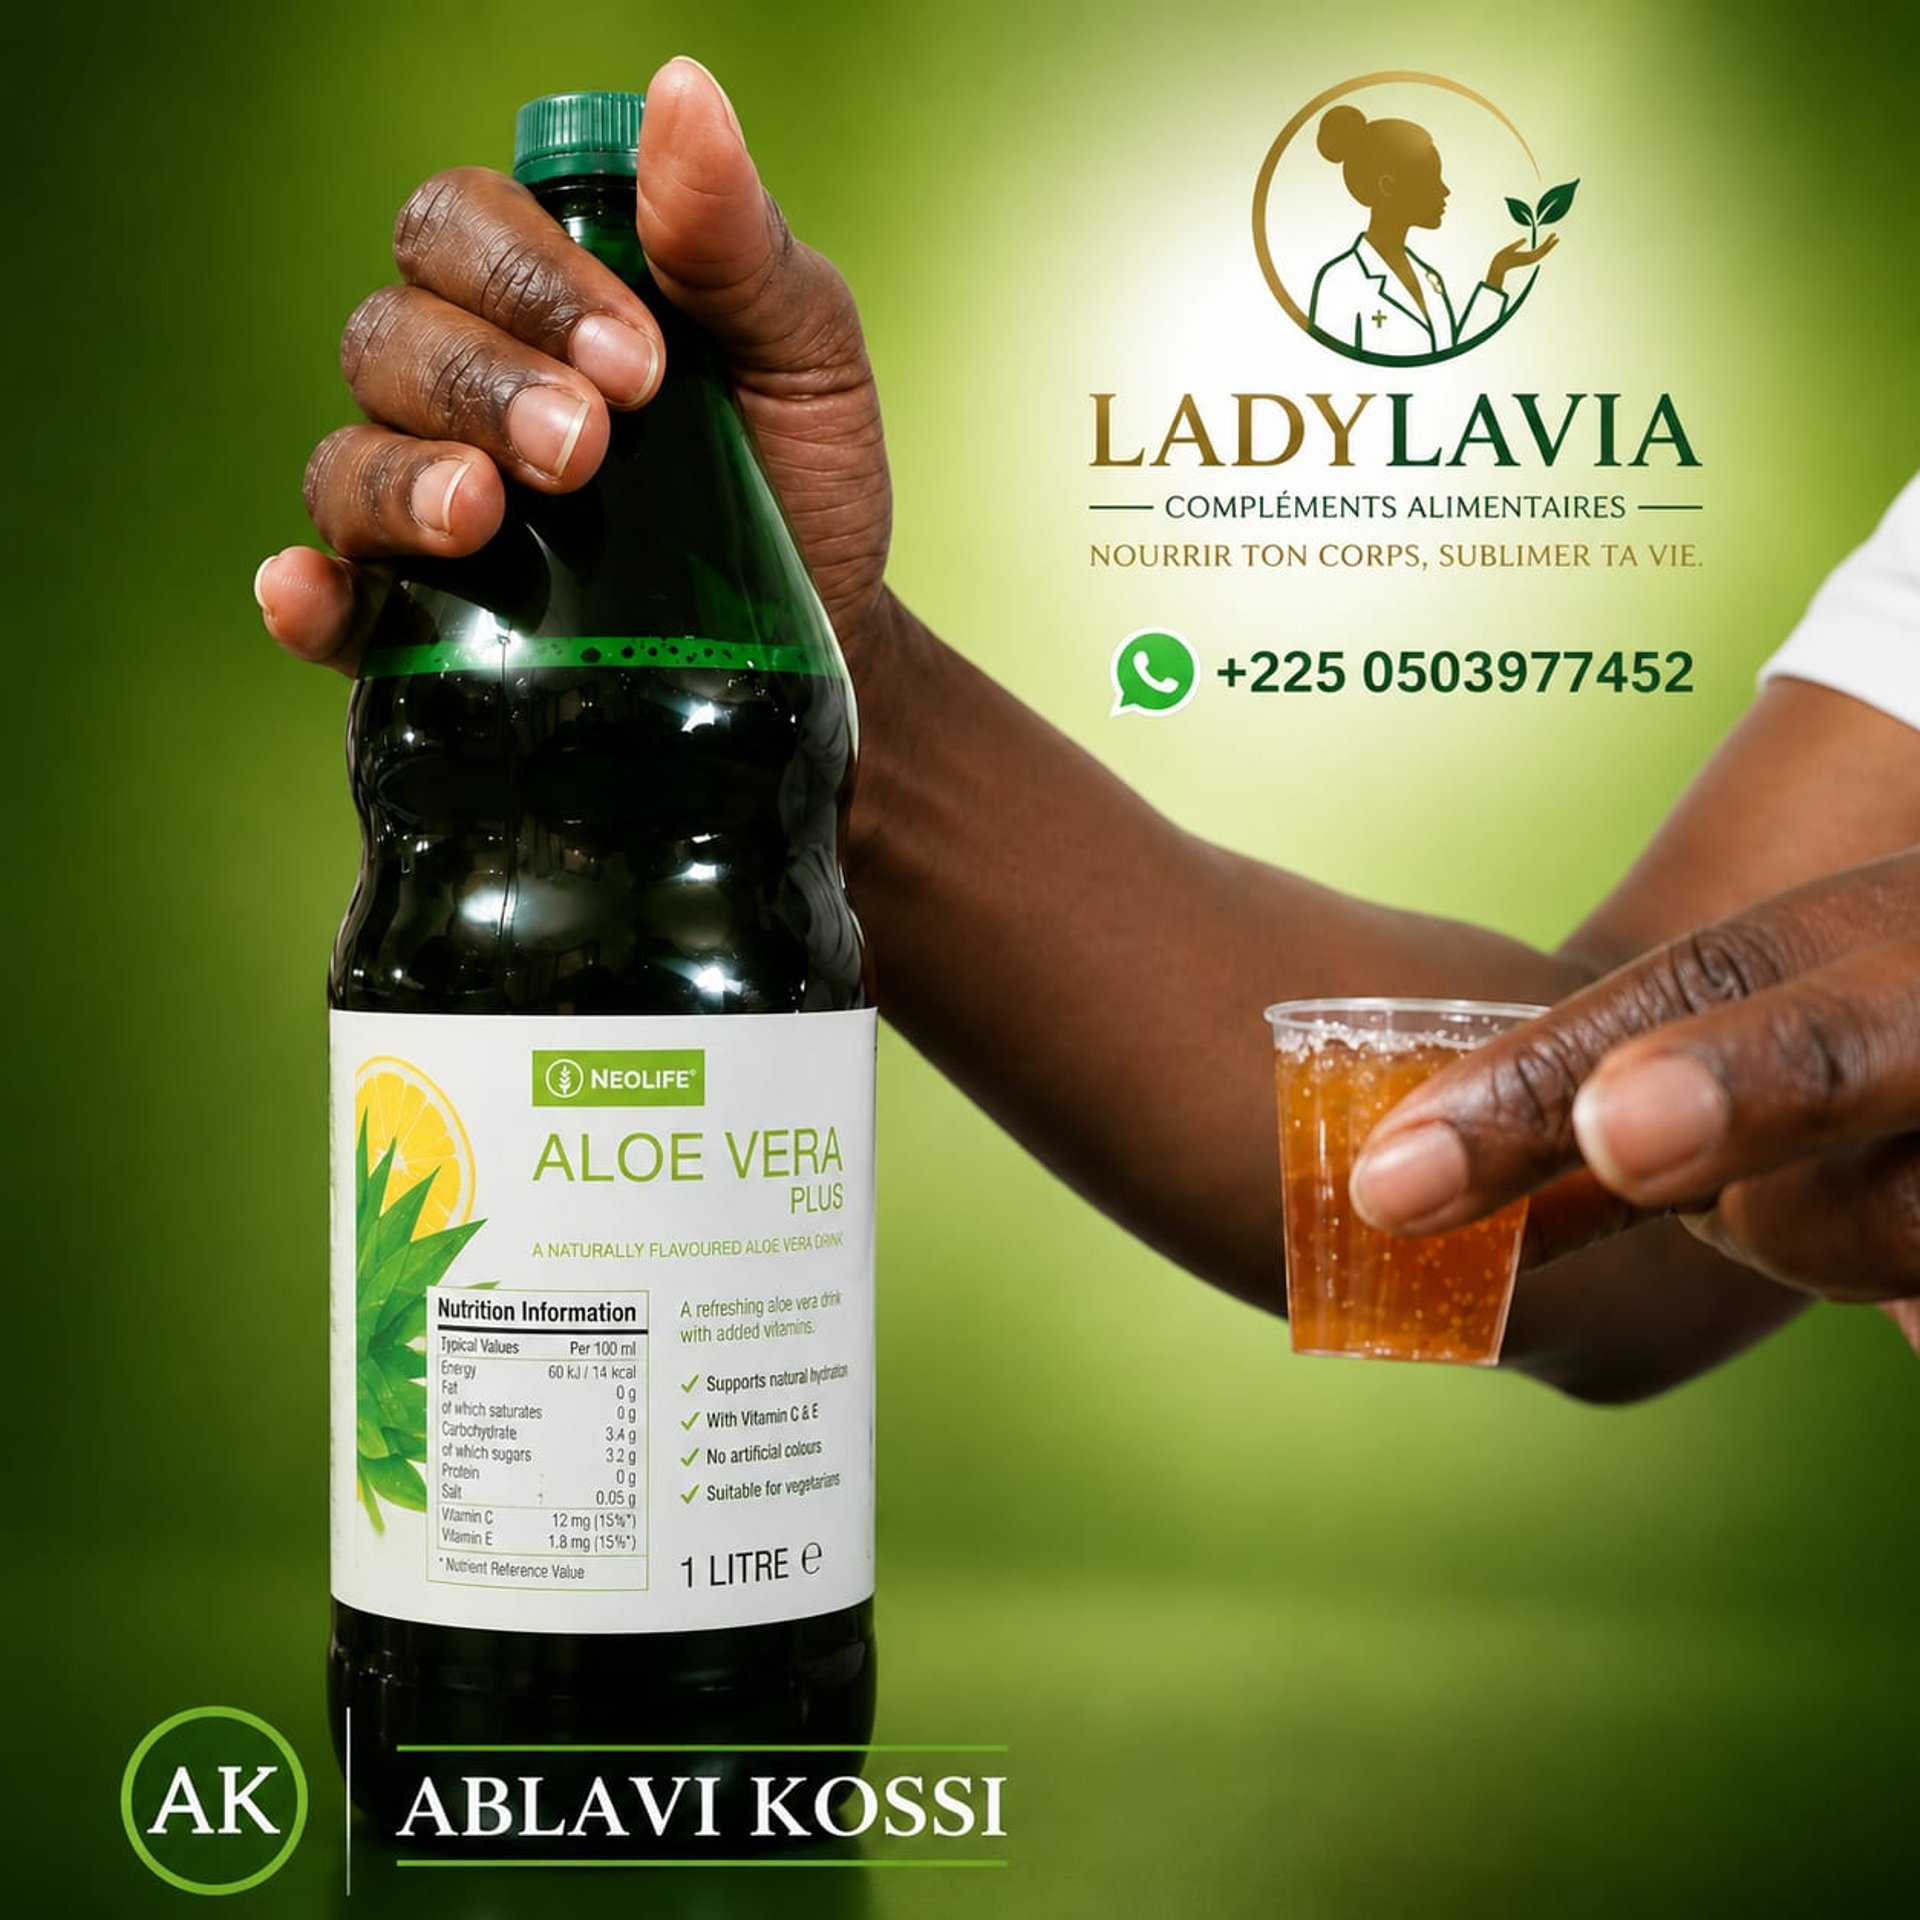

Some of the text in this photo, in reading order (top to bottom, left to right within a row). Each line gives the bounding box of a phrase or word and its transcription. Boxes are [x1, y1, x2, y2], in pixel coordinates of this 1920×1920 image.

[532, 1127, 843, 1183] ALOE VERA
[790, 1183, 843, 1214] PLUS
[532, 1234, 843, 1259] A NATURALLY FLAVOURED ALOE VERA DRINK
[438, 1297, 636, 1322] Nutrition Information
[680, 1301, 691, 1318] A
[696, 1297, 764, 1319] refreshing
[768, 1295, 793, 1313] aloe
[796, 1294, 819, 1310] vera
[681, 1318, 816, 1343] with added vitamins.
[481, 1339, 519, 1354] Values
[570, 1341, 636, 1356] Per 100 ml
[441, 1361, 476, 1379] Energy
[548, 1365, 564, 1379] 60
[567, 1365, 581, 1379] kJ
[594, 1366, 607, 1379] 14
[611, 1365, 636, 1379] kcal
[441, 1380, 458, 1394] Fat
[706, 1373, 766, 1394] Supports
[769, 1368, 808, 1386] natural
[616, 1385, 636, 1402] 0 g
[441, 1401, 543, 1419] of which saturates
[616, 1406, 636, 1423] 0 g
[706, 1403, 819, 1429] With Vitamin C & E
[628, 1430, 636, 1444] g
[441, 1444, 532, 1464] of which sugars
[628, 1451, 636, 1465] g
[706, 1440, 822, 1465] No artificial colours
[441, 1463, 479, 1479] Protein
[616, 1470, 636, 1487] 0 g
[441, 1483, 462, 1499] Salt
[706, 1472, 840, 1502] Suitable for vegetarians
[596, 1490, 636, 1508] 0.05 g
[484, 1510, 493, 1524] C
[552, 1513, 568, 1528] 12
[571, 1517, 590, 1531] mg
[485, 1531, 493, 1545] E
[549, 1535, 567, 1549] 1.8
[571, 1538, 590, 1552] mg
[446, 1558, 488, 1574] Nutrient
[491, 1561, 548, 1577] Reference
[552, 1565, 585, 1579] Value
[681, 1556, 694, 1588] 1
[709, 1548, 789, 1587] LITRE
